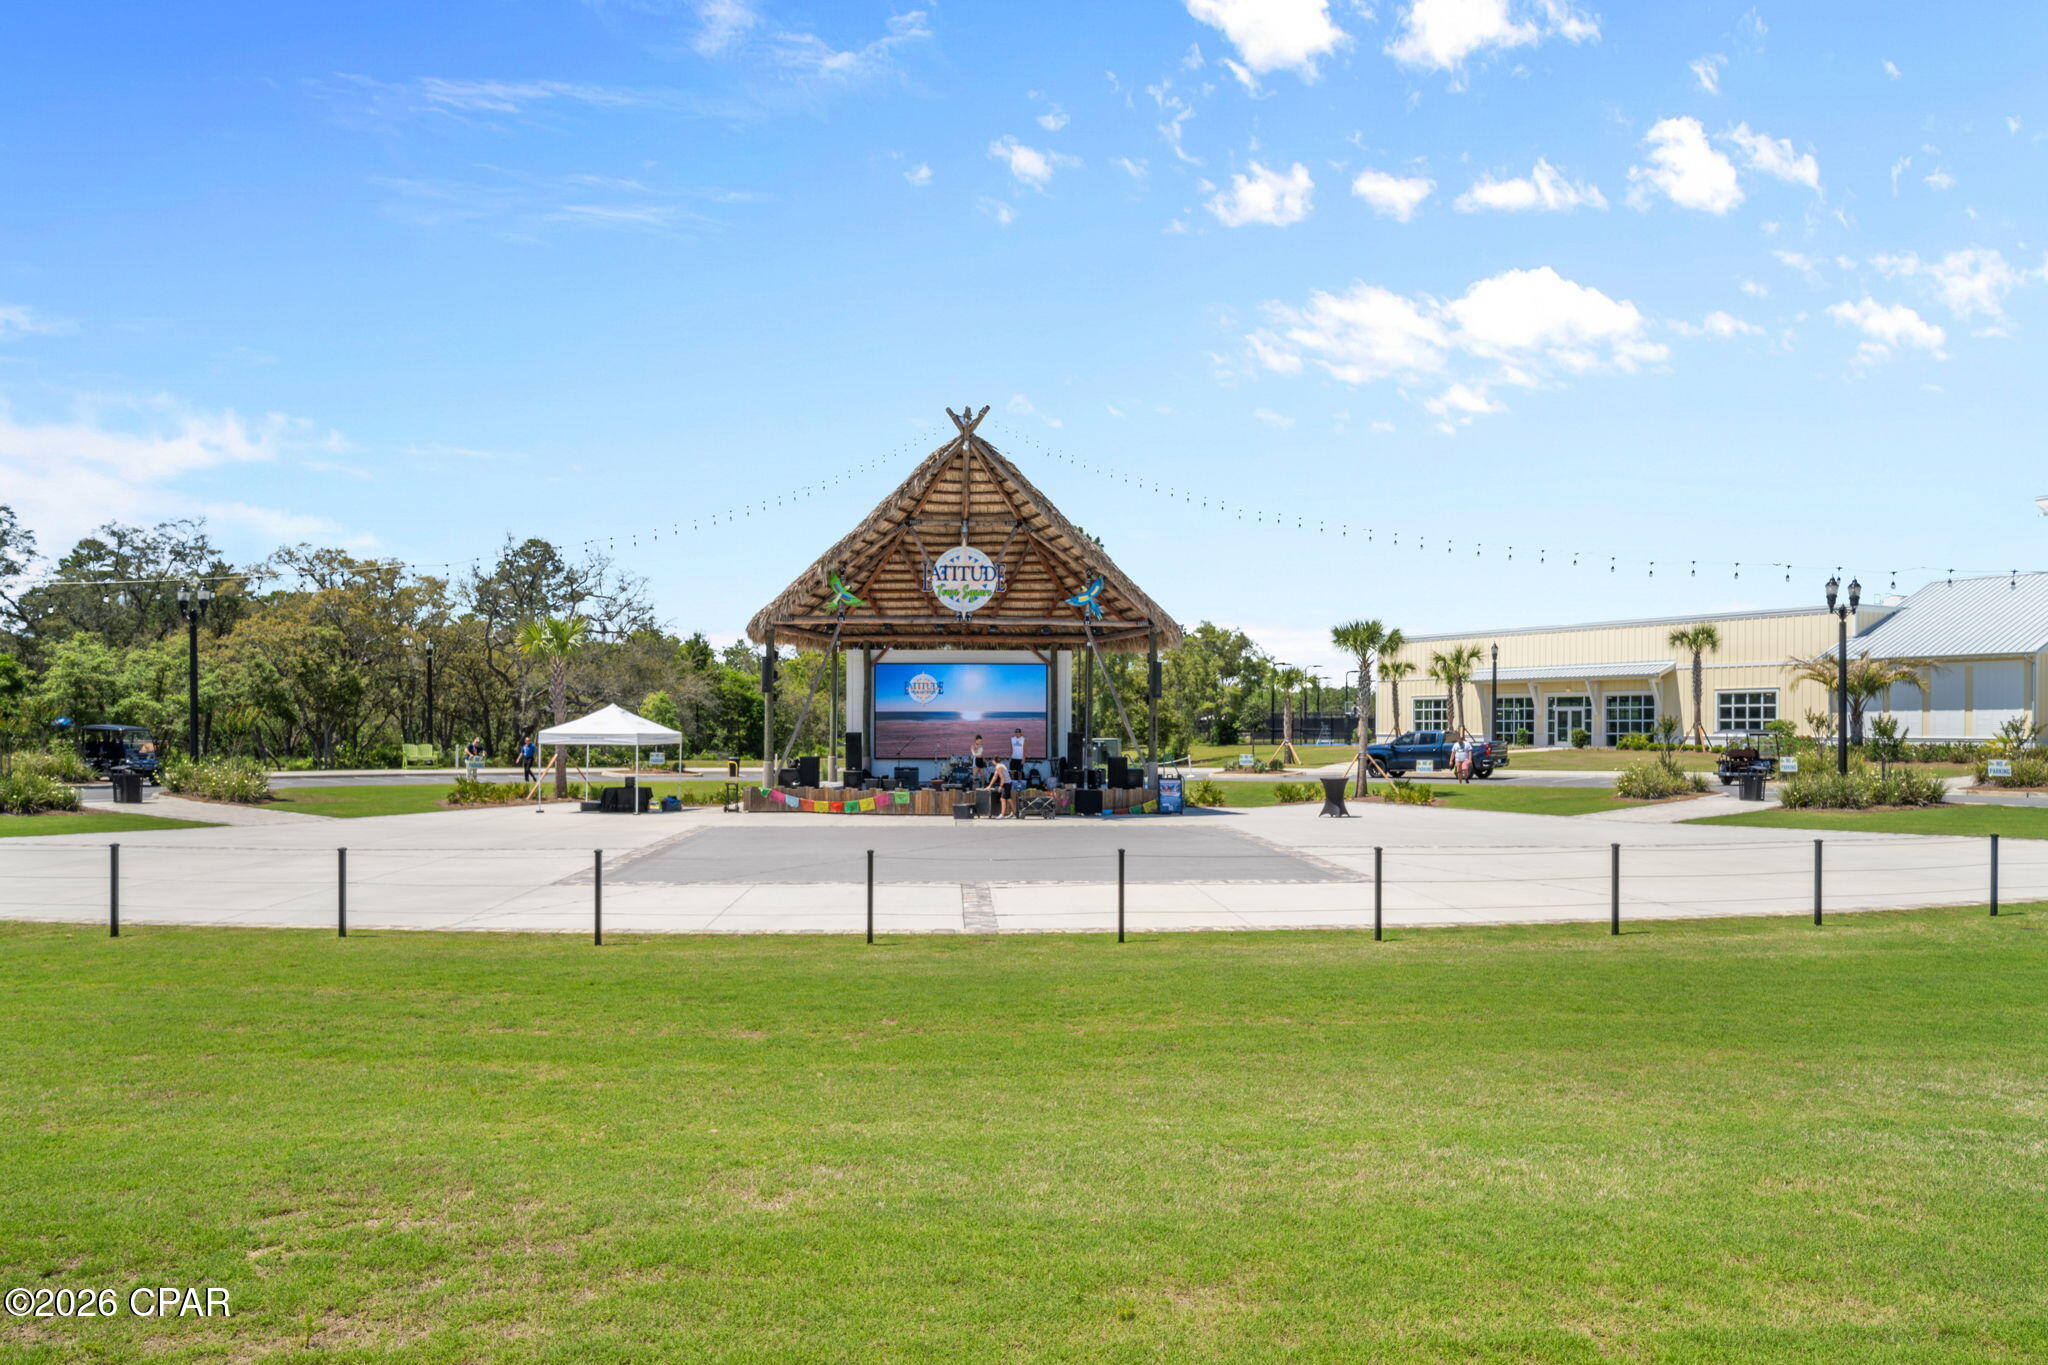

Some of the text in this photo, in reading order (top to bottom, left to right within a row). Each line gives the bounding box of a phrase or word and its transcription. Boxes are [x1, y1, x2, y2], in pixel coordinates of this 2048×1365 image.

[922, 563, 1006, 592] LATITUDE
[936, 584, 992, 602] Town Square
[1989, 767, 2011, 775] PARKING
